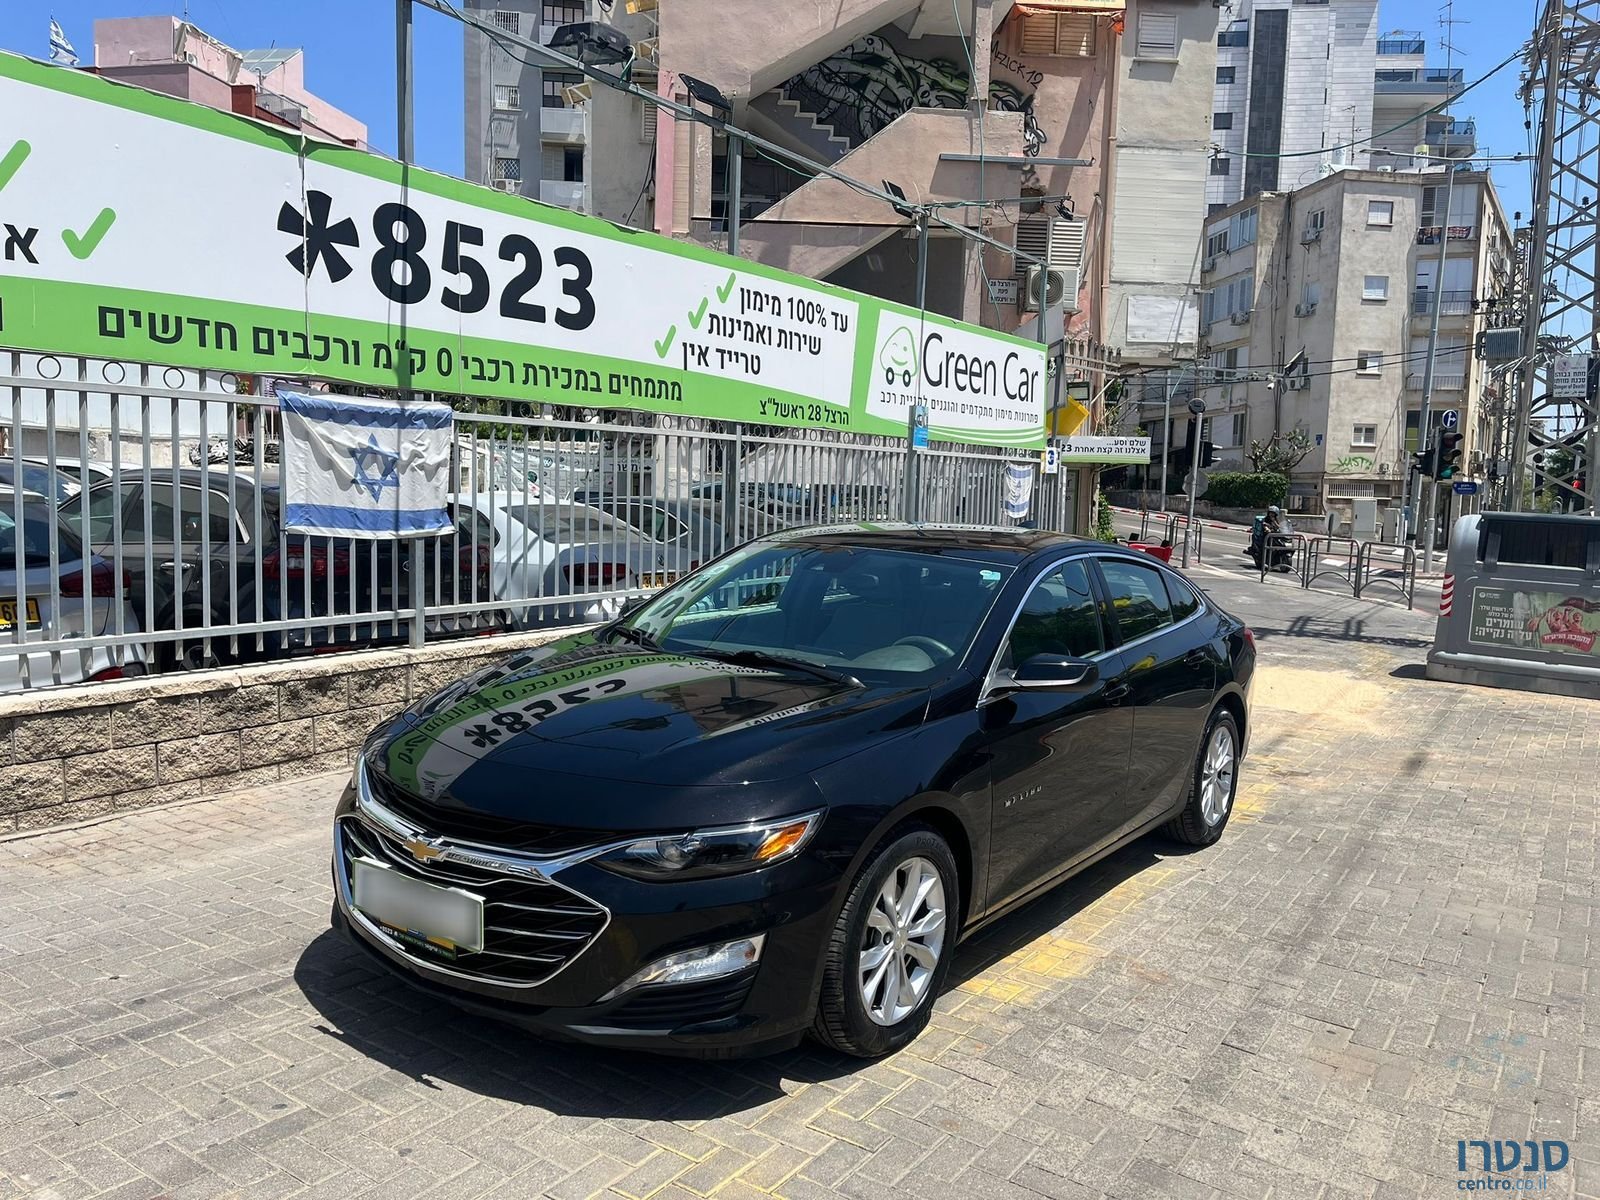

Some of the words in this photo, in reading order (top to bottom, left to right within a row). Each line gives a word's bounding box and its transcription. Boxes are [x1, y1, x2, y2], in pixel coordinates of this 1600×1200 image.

[739, 287, 781, 316] מימון
[787, 297, 827, 328] 100%
[98, 305, 238, 351] חדשים
[708, 313, 772, 346] ואמינות
[831, 311, 848, 333] עד
[252, 326, 360, 365] ורכבים
[682, 342, 710, 370] אין
[777, 329, 821, 356] שירות
[437, 347, 453, 377] 0
[461, 355, 515, 383] רכבי
[715, 348, 761, 375] טרייד
[923, 332, 997, 397] Green
[1003, 352, 1039, 403] Car
[522, 362, 602, 393] במכירת
[609, 373, 682, 401] מתמחים
[880, 391, 897, 403] רכב
[807, 405, 821, 422] 28
[824, 406, 849, 425] הרצל
[960, 403, 993, 420] מתקדמים
[995, 408, 1013, 421] מימון
[1074, 445, 1095, 453] אחרת
[1097, 446, 1113, 455] קצת
[1125, 446, 1146, 454] אצלנו
[1129, 439, 1147, 447] שלם
[1507, 629, 1532, 640] עלה
